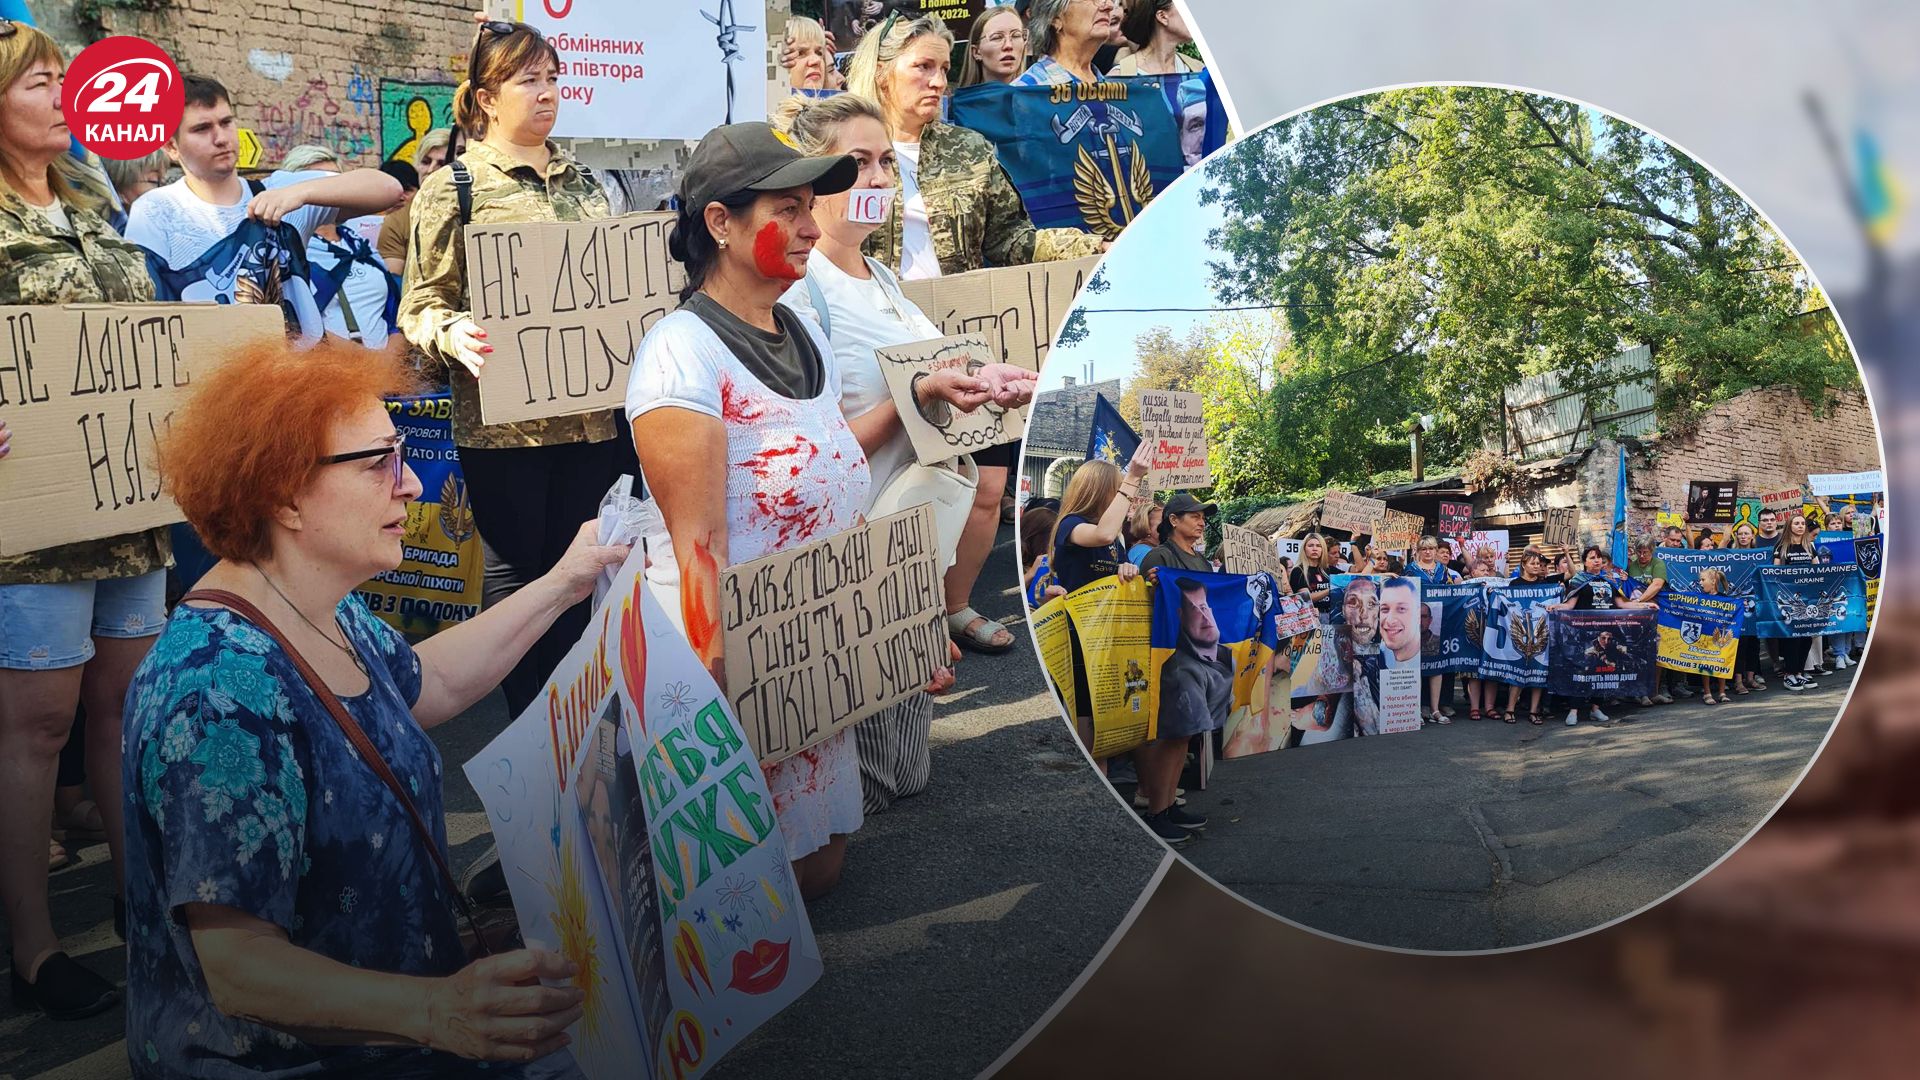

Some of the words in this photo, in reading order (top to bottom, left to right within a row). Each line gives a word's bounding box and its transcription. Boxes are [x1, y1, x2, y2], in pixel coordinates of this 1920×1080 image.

[558, 62, 567, 75] а
[573, 58, 644, 82] півтора
[560, 84, 594, 105] оку
[472, 232, 531, 320] НЕ
[552, 219, 687, 313] ДАЙТЕ
[0, 312, 50, 406] НЕ
[71, 311, 190, 396] ДАЙТЕ
[1174, 395, 1187, 409] has
[1142, 406, 1172, 427] illegally
[1145, 428, 1155, 443] my
[1158, 425, 1182, 439] husband
[1184, 428, 1190, 439] to
[406, 446, 434, 460] ТАТО
[445, 450, 461, 462] СЕ
[1187, 441, 1198, 456] for
[1286, 543, 1299, 553] 36
[404, 547, 458, 567] БРИГАДА
[1657, 552, 1706, 563] ОРКЕСТР
[1708, 551, 1767, 562] МОРСЬКОЇ
[725, 524, 874, 632] ЗАКАТОВАНІ
[1762, 567, 1815, 575] ORCHESTRA
[1816, 564, 1858, 573] MARINES
[373, 571, 421, 587] ОРСЬКОЇ
[421, 575, 465, 593] ПІХОТИ
[1794, 576, 1825, 584] UKRAINE
[1426, 587, 1452, 597] ВІРНИЙ
[1514, 588, 1543, 599] ПІХОТА
[384, 595, 396, 612] З
[399, 597, 478, 622] ПОЛОНУ
[1668, 593, 1698, 605] ВІРНИЙ
[1700, 598, 1736, 611] ЗАВЖДИ
[747, 602, 846, 686] ГИНУТЬ
[853, 589, 873, 638] В
[1442, 638, 1460, 655] 36
[1421, 659, 1449, 670] БРИГАДА
[1698, 663, 1730, 674] ПОЛОНУ
[1604, 674, 1620, 682] МОЮ
[1620, 673, 1637, 682] ДУШУ
[735, 667, 818, 762] ПОКИ
[824, 645, 867, 725] ВИ
